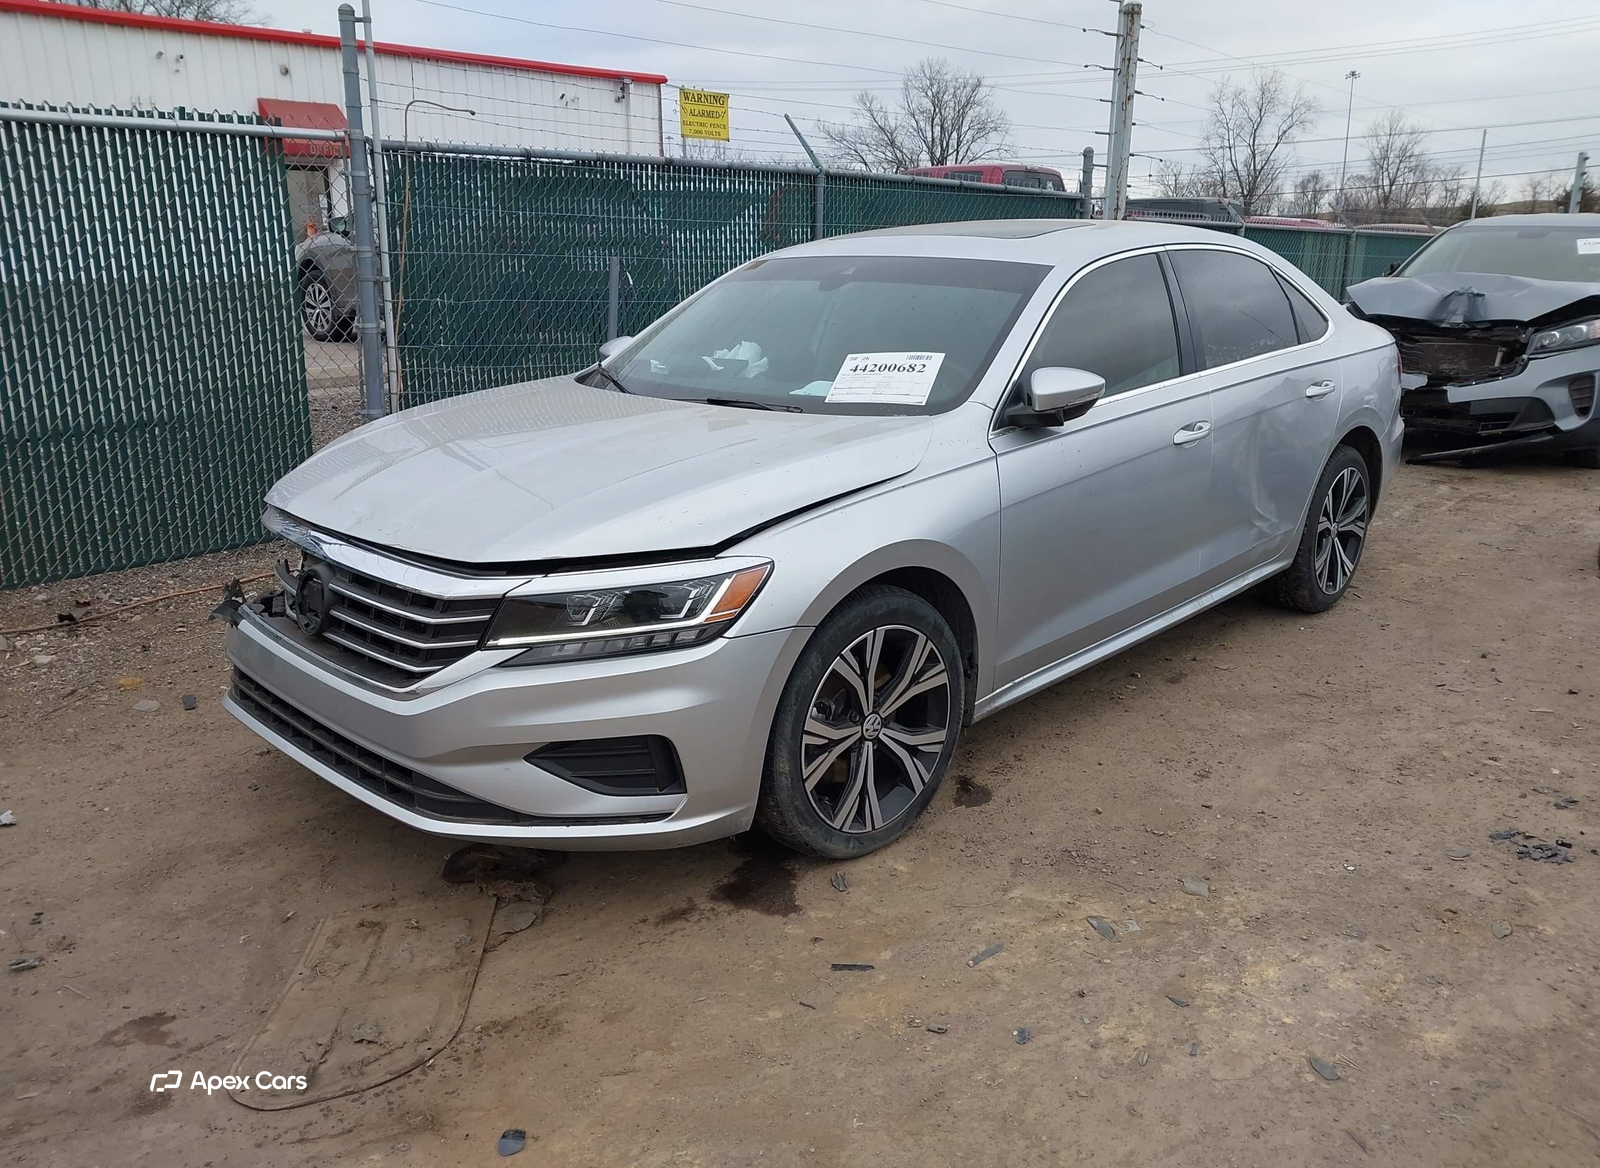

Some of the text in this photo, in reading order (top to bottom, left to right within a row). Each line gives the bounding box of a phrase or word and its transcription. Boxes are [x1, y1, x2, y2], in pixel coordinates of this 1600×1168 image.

[683, 91, 725, 106] WARNING
[689, 108, 721, 119] ALARMED
[682, 120, 727, 130] ELECTRIC FENCE
[849, 363, 927, 373] 44200682
